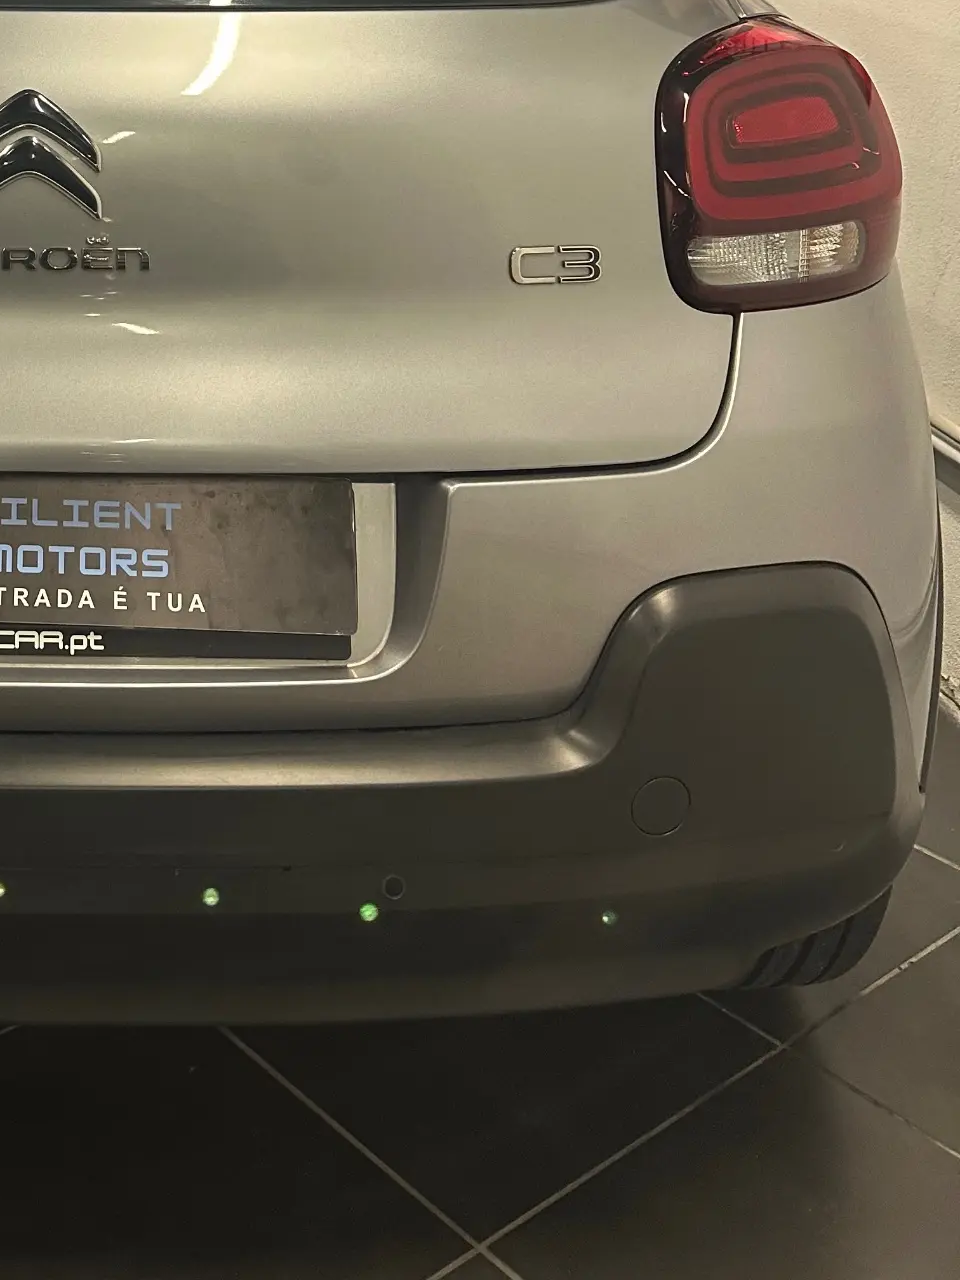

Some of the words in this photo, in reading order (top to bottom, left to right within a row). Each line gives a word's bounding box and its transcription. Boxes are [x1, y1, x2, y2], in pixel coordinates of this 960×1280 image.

[508, 245, 602, 285] C3
[113, 585, 128, 611] É
[147, 591, 206, 613] TUA
